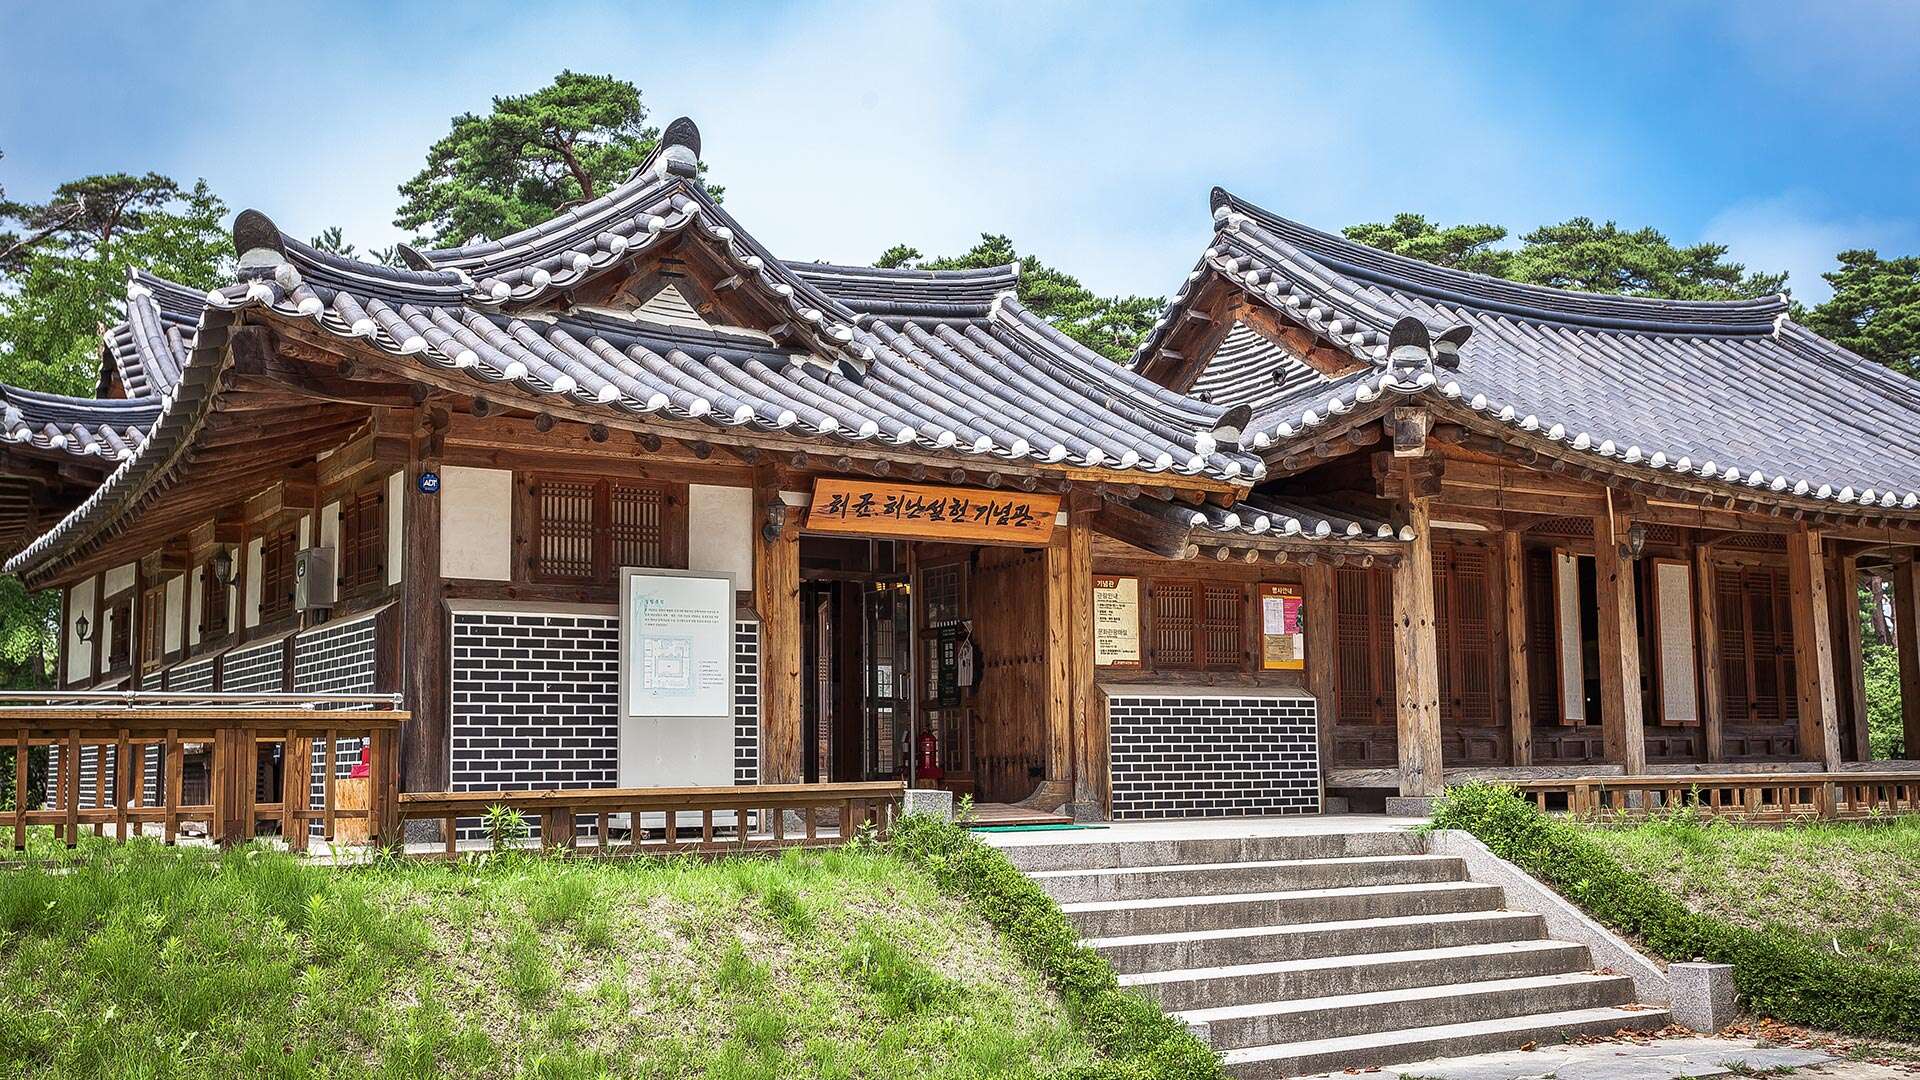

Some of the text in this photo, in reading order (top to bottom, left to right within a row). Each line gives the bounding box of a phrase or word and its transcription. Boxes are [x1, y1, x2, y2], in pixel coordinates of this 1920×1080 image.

[424, 479, 437, 487] ADT
[884, 494, 969, 522] 허난설헌
[974, 500, 1034, 527] 기념관
[1096, 580, 1115, 588] 기념관
[1271, 586, 1293, 595] 행사안내
